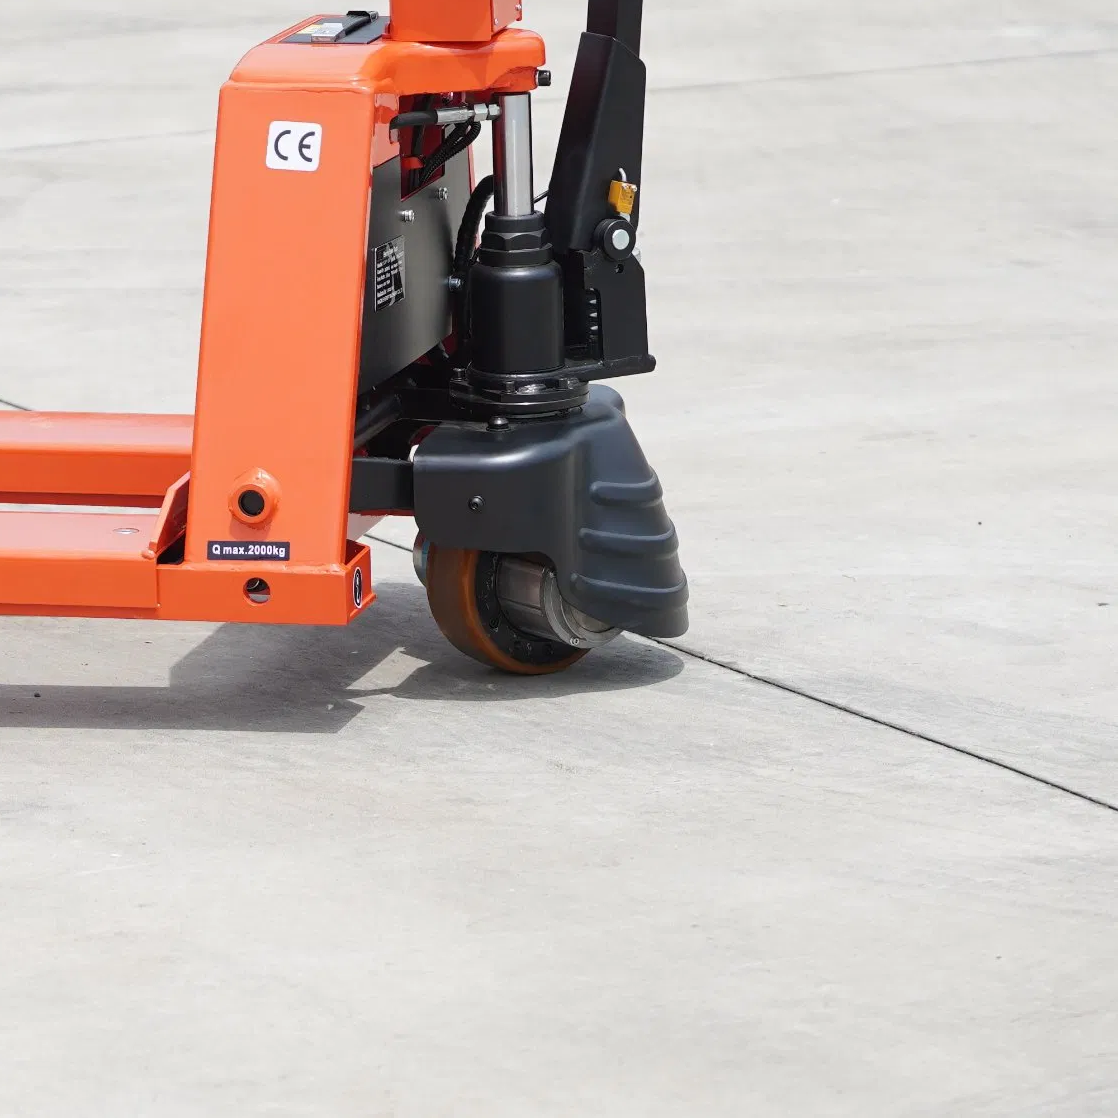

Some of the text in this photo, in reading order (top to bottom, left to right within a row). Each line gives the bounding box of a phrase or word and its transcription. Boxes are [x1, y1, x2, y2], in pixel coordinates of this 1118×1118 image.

[274, 130, 315, 162] CE
[212, 544, 286, 558] Q max.2000kg
